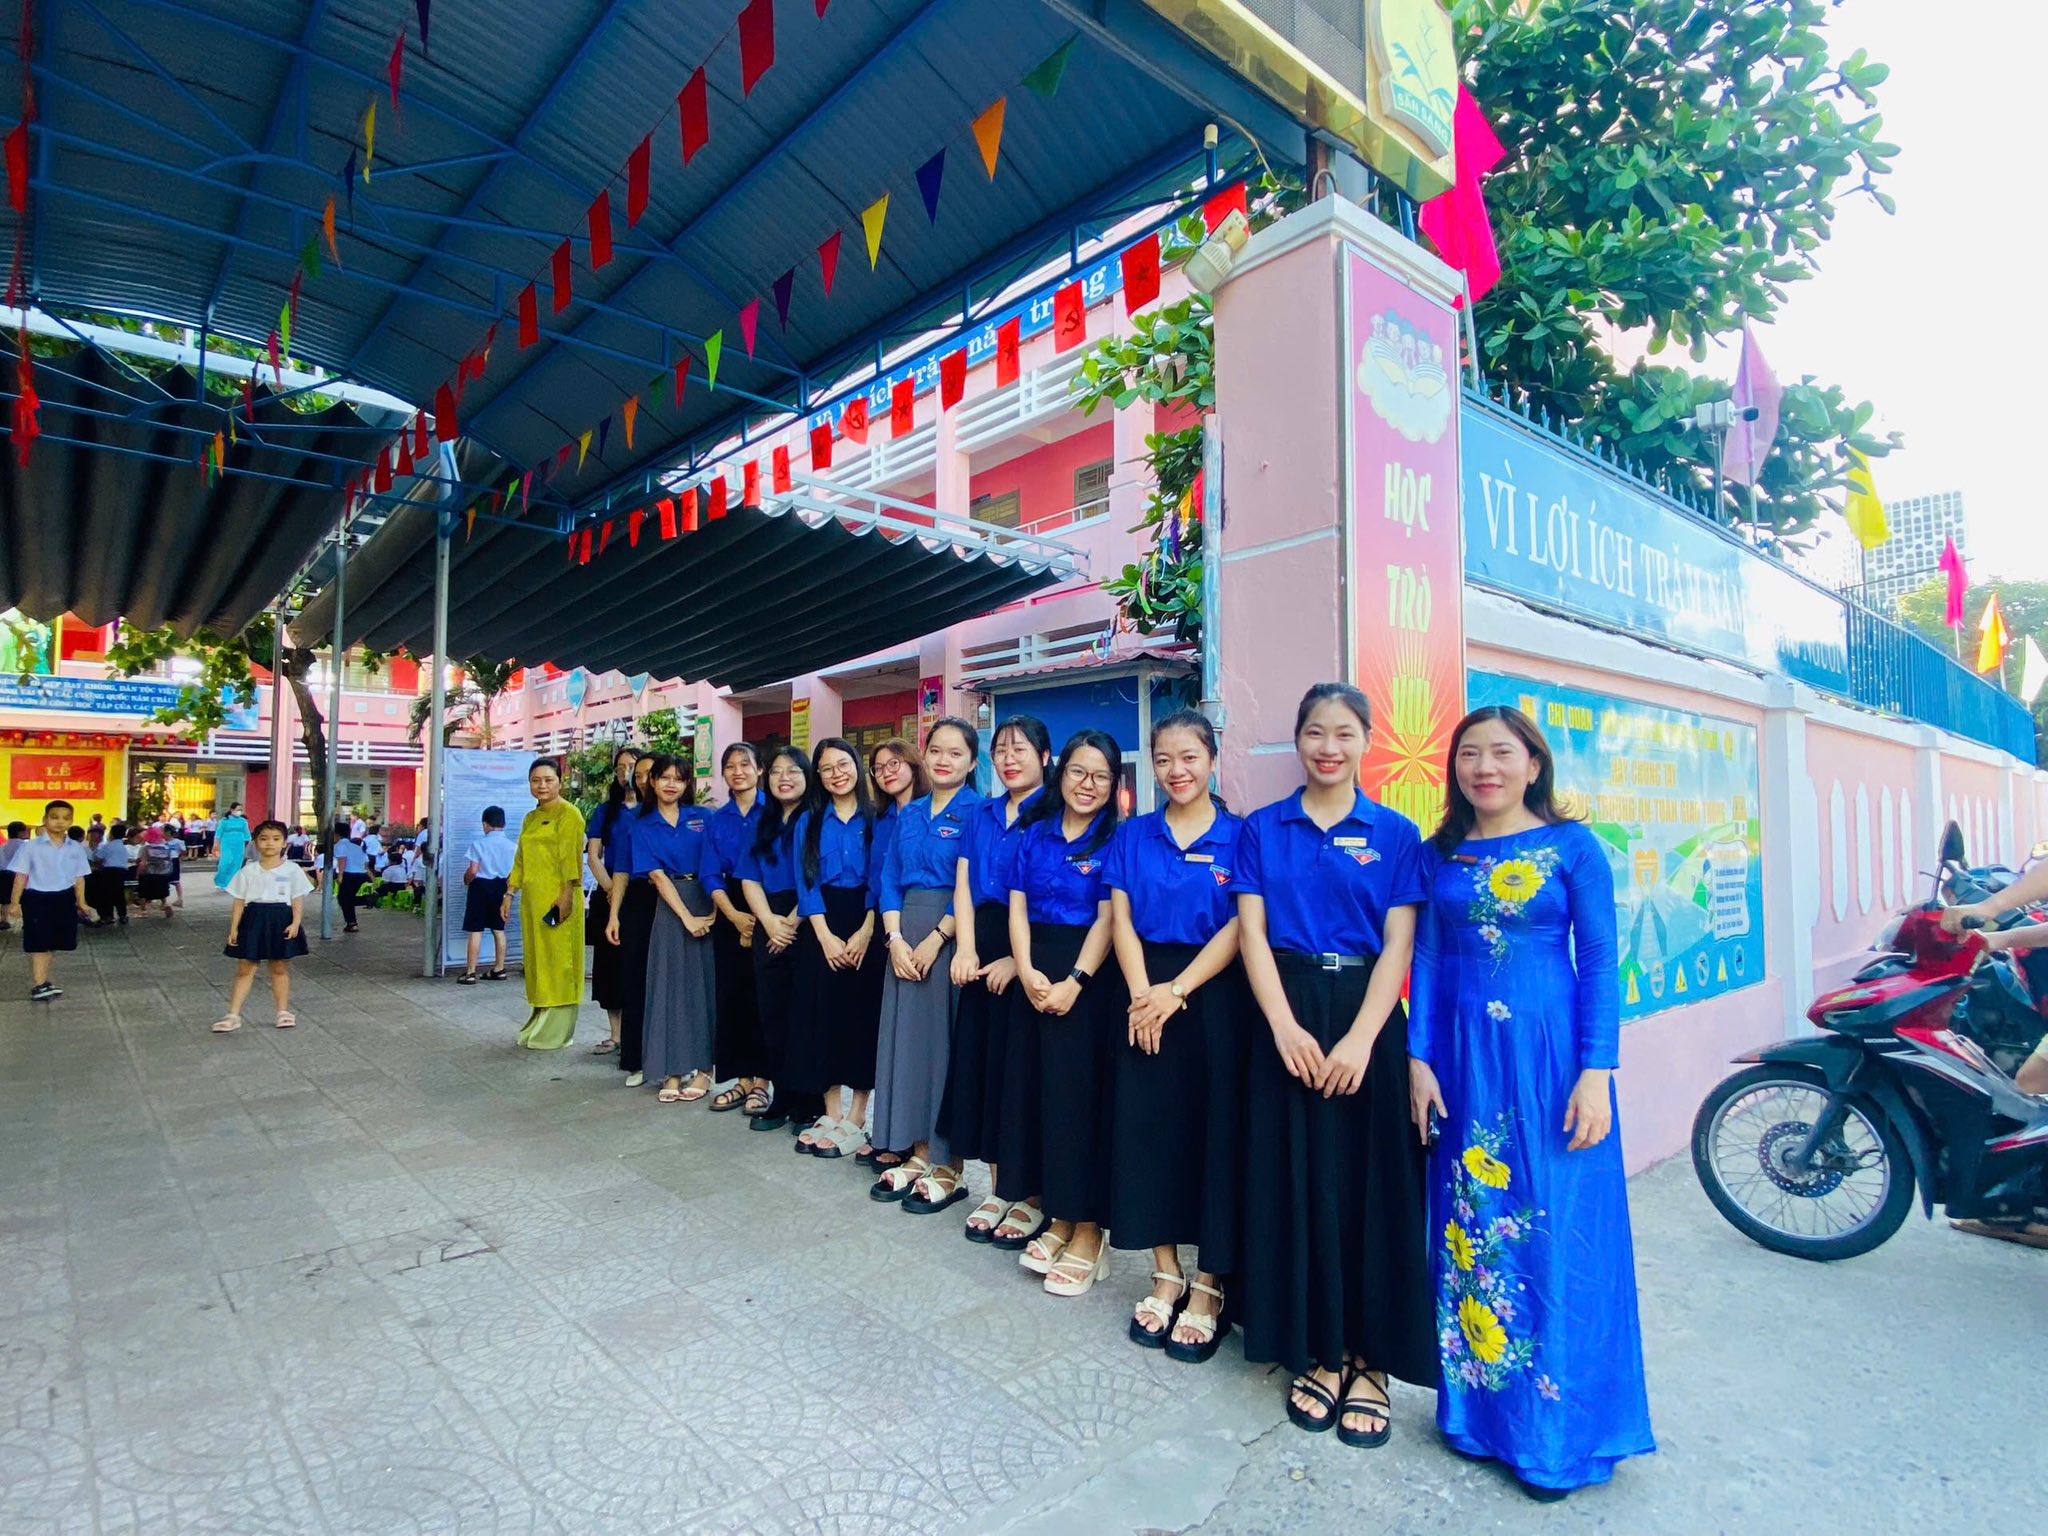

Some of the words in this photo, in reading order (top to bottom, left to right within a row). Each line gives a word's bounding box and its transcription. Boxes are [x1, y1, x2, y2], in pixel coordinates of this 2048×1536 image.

[1384, 462, 1431, 538] HỌC
[1480, 458, 1519, 556] VÌ
[1527, 494, 1583, 590] LỢI
[1588, 500, 1636, 598] ÍCH
[1387, 563, 1432, 633] TRÒ
